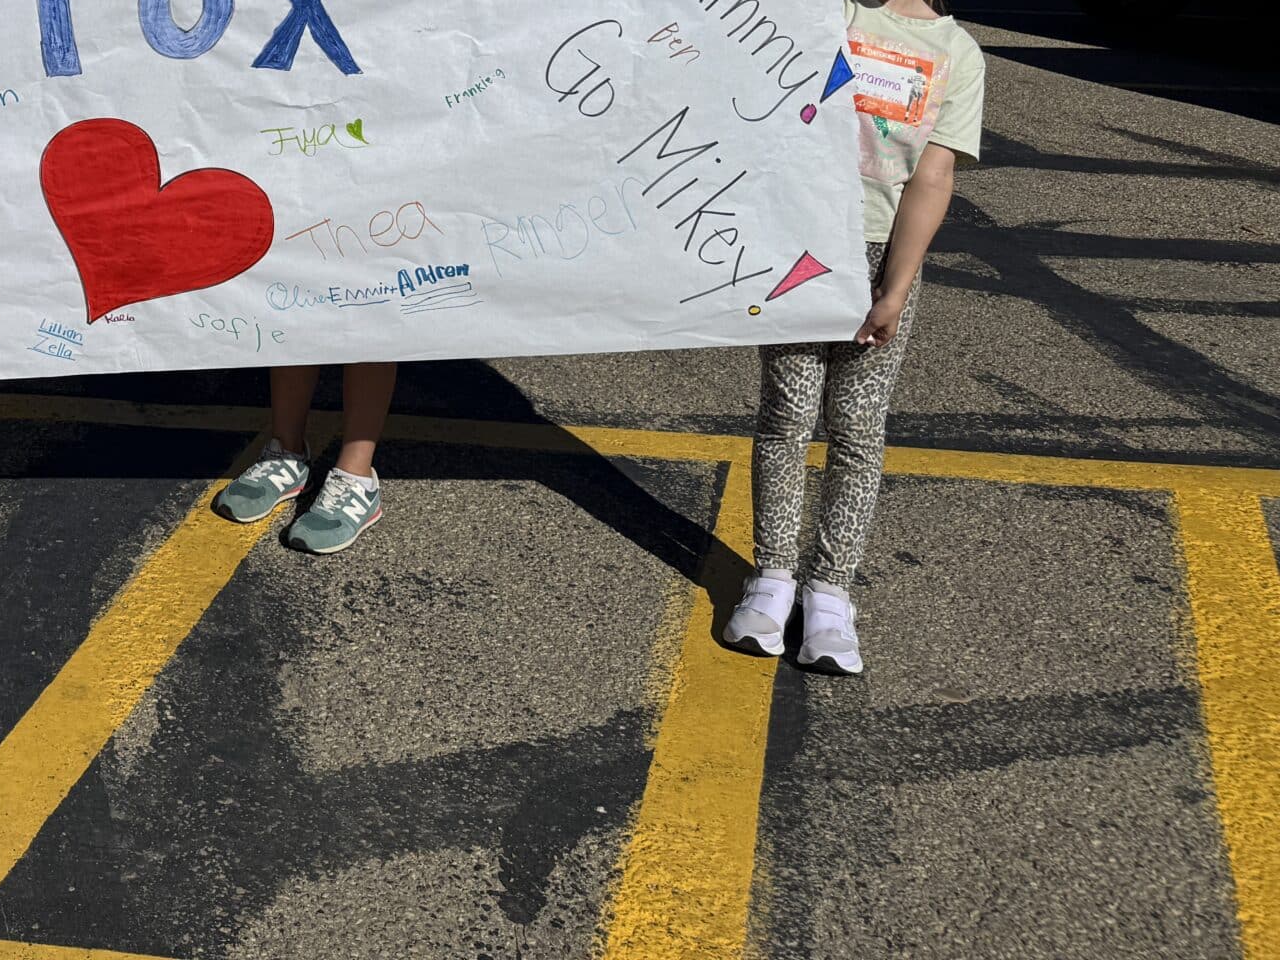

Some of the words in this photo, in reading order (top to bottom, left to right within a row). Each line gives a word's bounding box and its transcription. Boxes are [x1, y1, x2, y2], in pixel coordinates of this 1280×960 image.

[546, 19, 623, 117] Go
[647, 22, 700, 66] Ben
[285, 200, 444, 261] Thea
